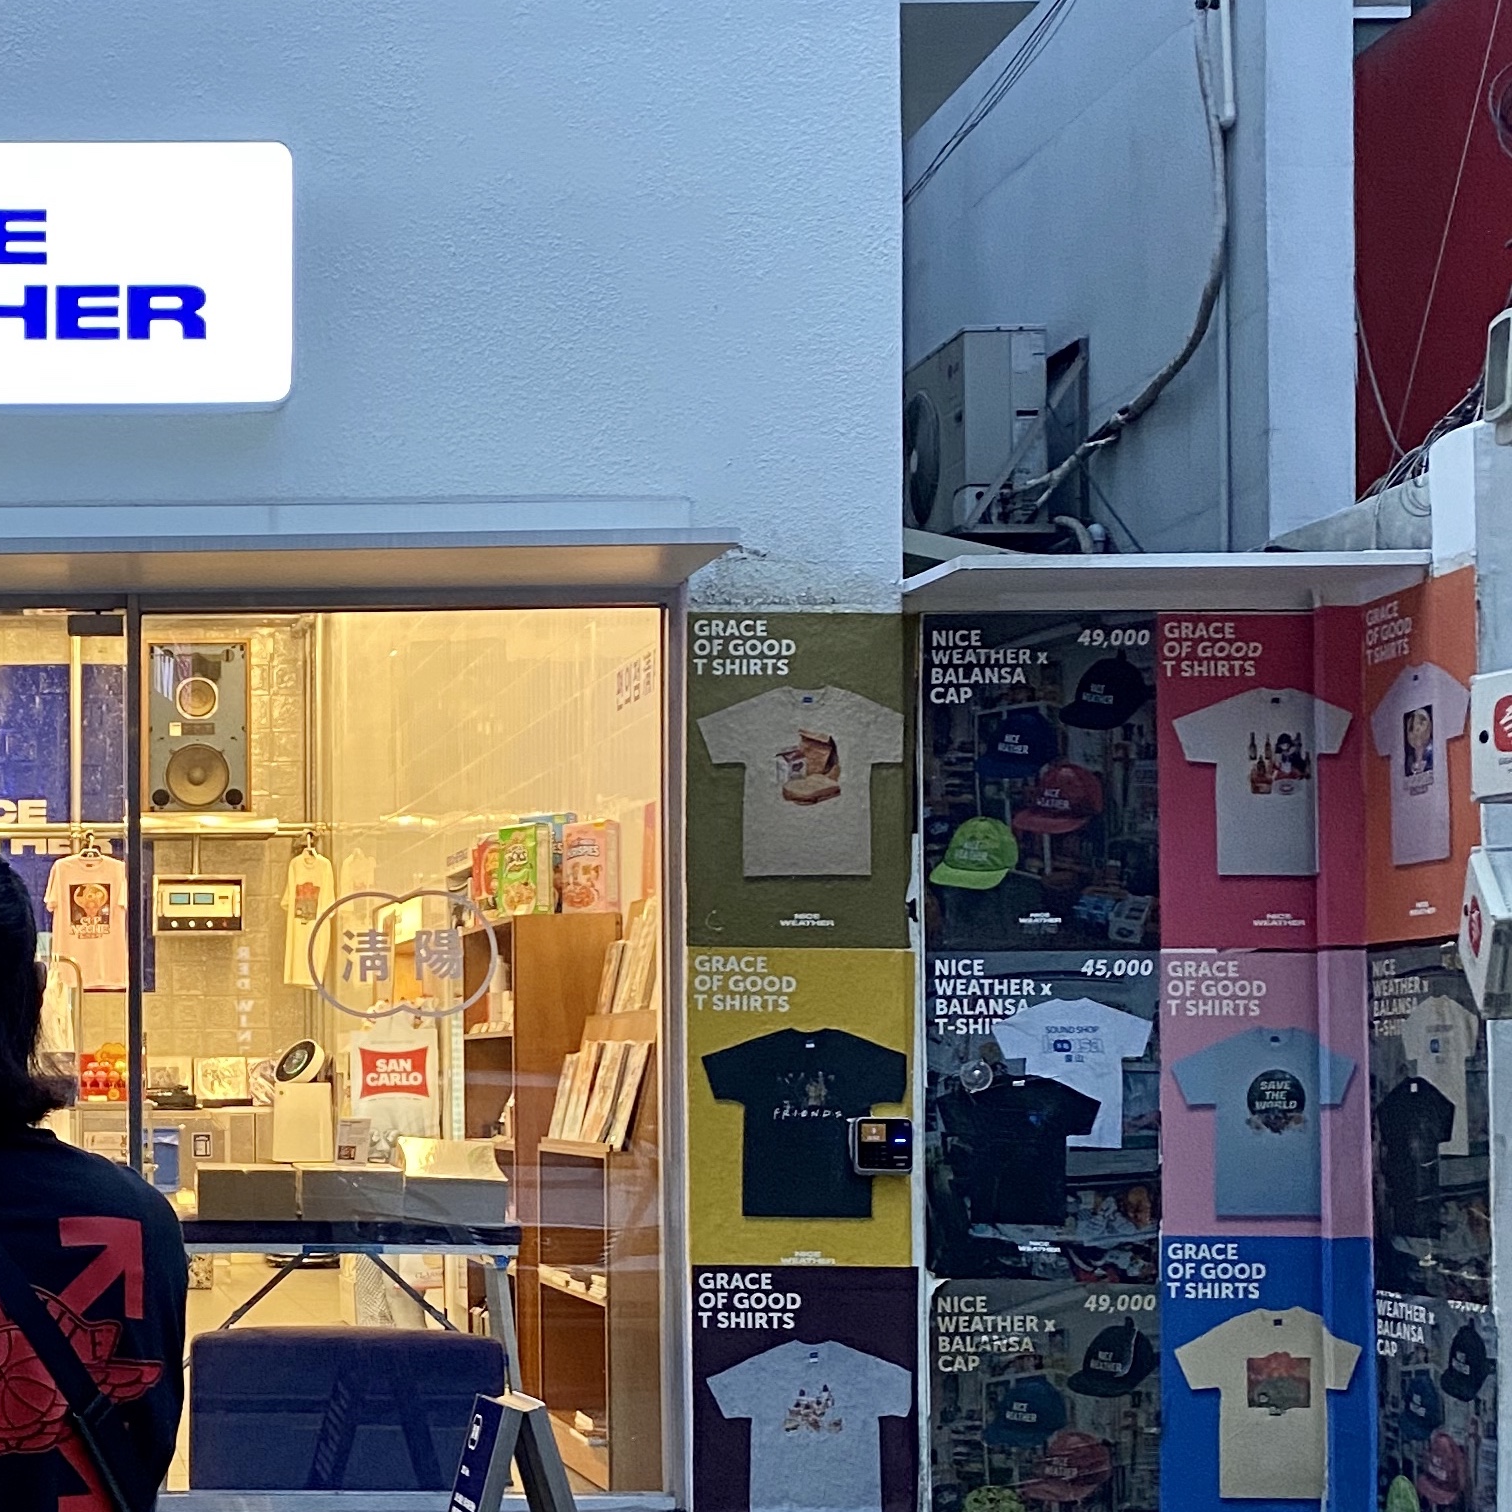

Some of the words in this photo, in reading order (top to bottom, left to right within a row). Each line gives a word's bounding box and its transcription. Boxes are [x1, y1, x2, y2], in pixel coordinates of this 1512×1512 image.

[1366, 601, 1399, 626] GRACE
[694, 620, 767, 636] GRACE
[1165, 622, 1235, 639] GRACE
[1366, 627, 1378, 646] OF
[1381, 617, 1413, 640] GOOD
[932, 630, 981, 646] NICE
[1078, 629, 1150, 648] 49,000
[694, 639, 723, 656] OF
[729, 639, 796, 656] GOOD
[1164, 642, 1191, 657] OF
[1197, 642, 1262, 658] GOOD
[1374, 638, 1410, 663] SHIRTS
[932, 650, 1031, 665] WEATHER
[694, 659, 704, 675] T
[713, 659, 789, 676] SHIRTS
[931, 668, 1026, 684] BALANSA
[1163, 660, 1175, 676] T
[1181, 660, 1256, 677] SHIRTS
[930, 688, 973, 704] CAP
[694, 956, 768, 973] GRACE
[935, 959, 984, 976] NICE
[1081, 959, 1153, 978] 45,000
[1168, 961, 1238, 978] GRACE
[1372, 959, 1396, 977] NICE
[694, 975, 723, 992] OF
[729, 975, 797, 993] GOOD
[935, 979, 1035, 995] WEATHER
[1168, 980, 1195, 996] OF
[1201, 980, 1266, 997] GOOD
[1373, 977, 1420, 997] WEATHER
[694, 995, 704, 1011] T
[713, 995, 790, 1012] SHIRTS
[935, 999, 1028, 1015] BALANSA
[1168, 1000, 1178, 1016] T
[1185, 1000, 1260, 1017] SHIRTS
[934, 1018, 1004, 1035] T-SHI
[376, 1059, 412, 1072] SAN
[366, 1072, 423, 1087] CARLO
[1260, 1080, 1290, 1090] SAVE
[1265, 1090, 1287, 1100] THE
[1254, 1100, 1297, 1111] WORLD
[1168, 1244, 1238, 1260] GRACE
[1168, 1263, 1195, 1280] OF
[1201, 1263, 1266, 1280] GOOD
[699, 1273, 772, 1290] GRACE
[1168, 1283, 1178, 1299] T
[1185, 1282, 1260, 1299] SHIRTS
[699, 1293, 727, 1309] OF
[733, 1293, 802, 1310] GOOD
[938, 1297, 987, 1313] NICE
[1084, 1295, 1156, 1314] 49,000
[1376, 1298, 1426, 1324] WEATHER
[699, 1313, 709, 1329] T
[717, 1312, 795, 1330] SHIRTS
[938, 1316, 1038, 1333] WEATHER
[1377, 1318, 1425, 1344] BALANSA
[938, 1336, 1034, 1353] BALANSA
[1377, 1339, 1397, 1357] CAP
[938, 1356, 980, 1373] CAP
